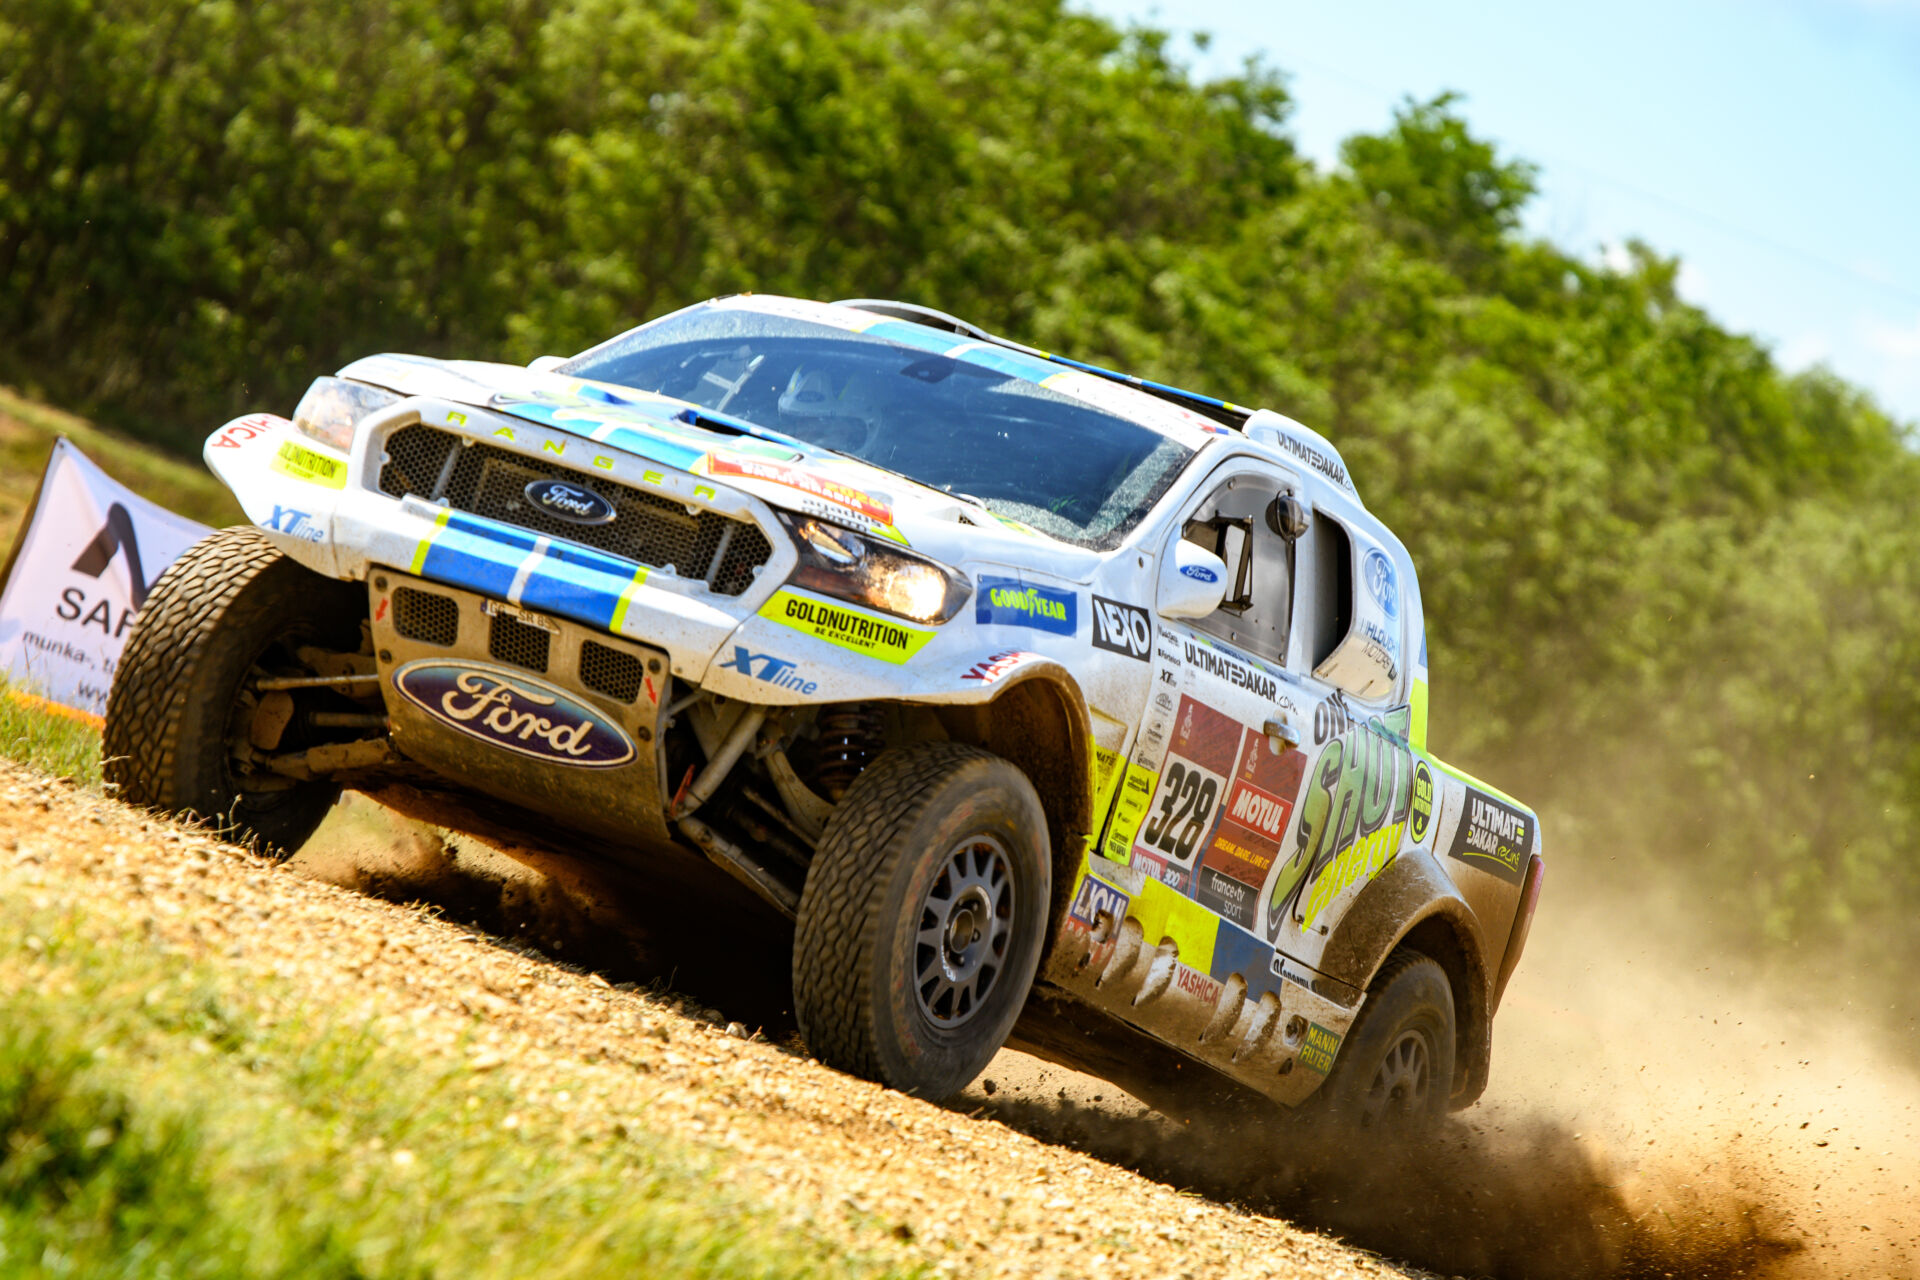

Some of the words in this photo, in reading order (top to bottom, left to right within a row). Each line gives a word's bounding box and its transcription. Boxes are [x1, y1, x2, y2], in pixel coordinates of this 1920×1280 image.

[446, 410, 716, 501] RANGER
[541, 483, 594, 516] Ford
[261, 504, 324, 542] XTline
[1186, 567, 1212, 581] Ford
[989, 586, 1066, 621] GOODYEAR
[785, 598, 908, 650] GOLDNUTRITION
[814, 626, 826, 638] BE
[828, 629, 877, 650] EXCELLENT
[1094, 600, 1150, 657] NEXO
[719, 645, 817, 695] XTline
[441, 671, 592, 757] Ford
[1144, 761, 1218, 861] 328
[1231, 788, 1284, 835] MOTUL
[1471, 797, 1525, 846] ULTIMATE
[1466, 824, 1499, 856] DAKAR
[1133, 852, 1161, 882] MOTUL
[1177, 966, 1219, 1007] YASHICA
[1300, 1044, 1332, 1072] FILTER
[1307, 1026, 1337, 1054] MANN
